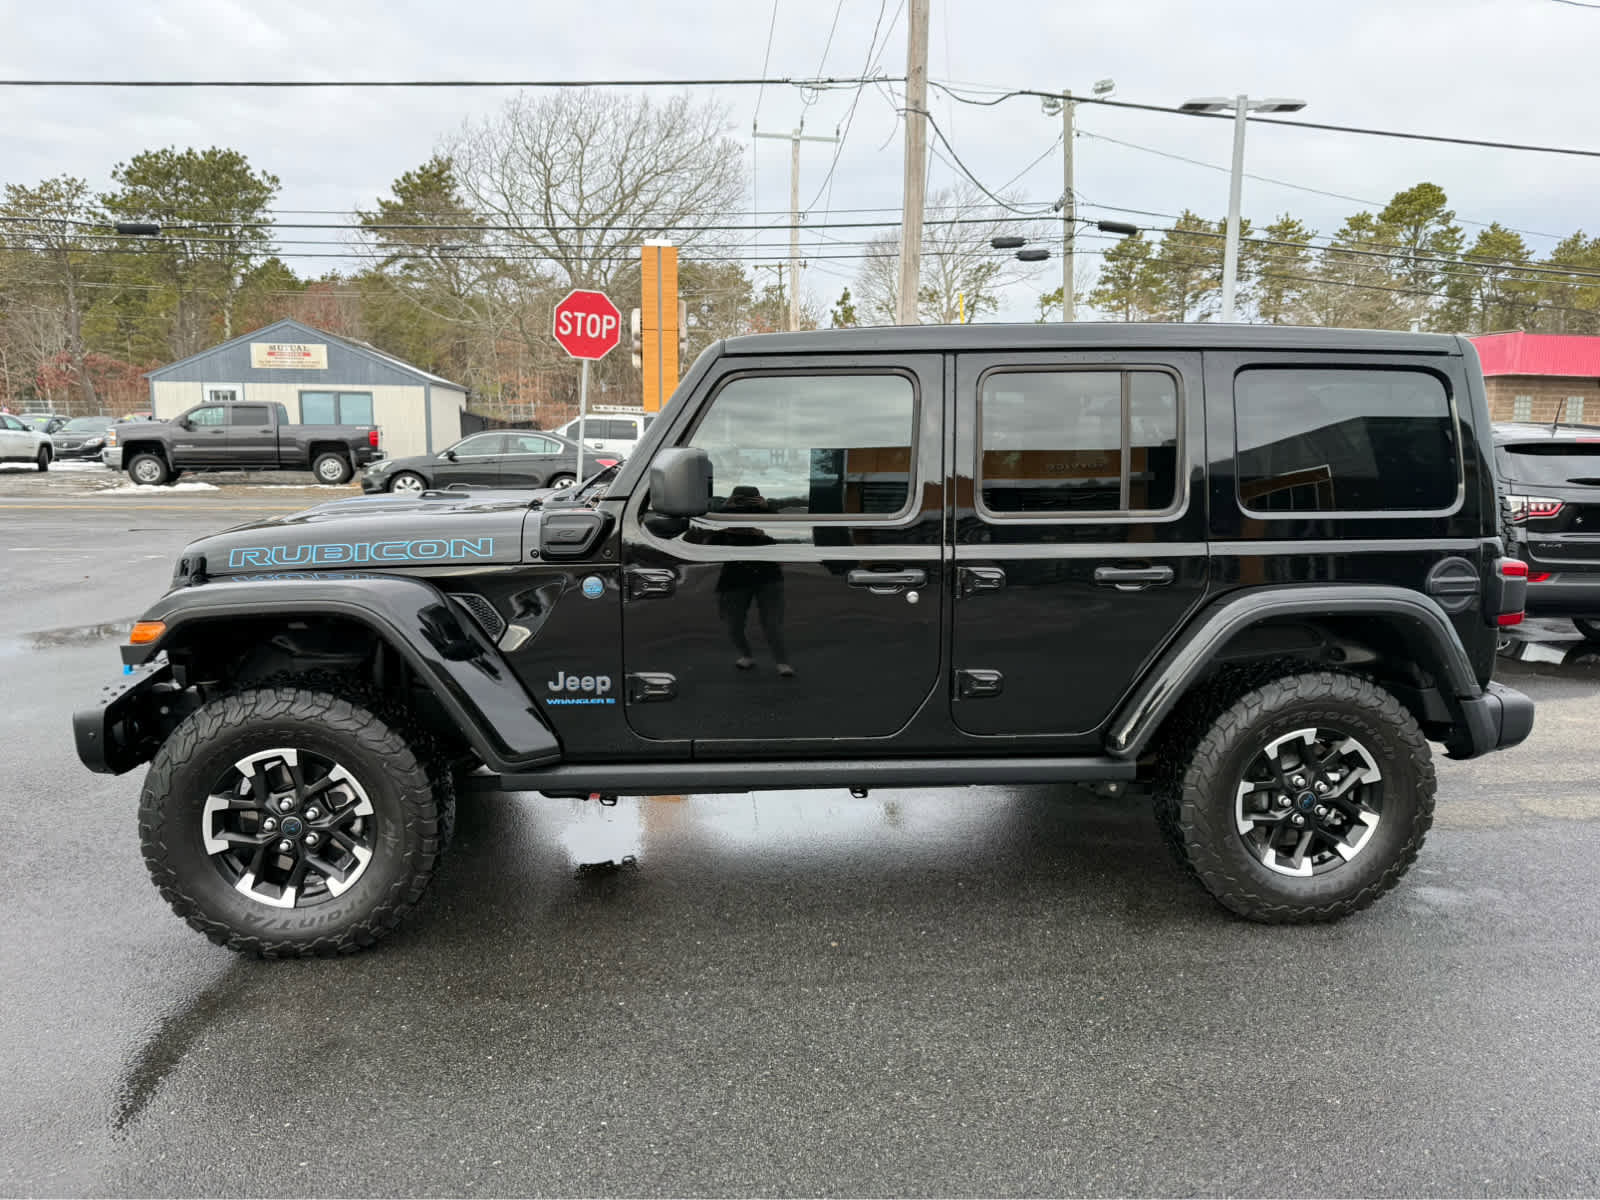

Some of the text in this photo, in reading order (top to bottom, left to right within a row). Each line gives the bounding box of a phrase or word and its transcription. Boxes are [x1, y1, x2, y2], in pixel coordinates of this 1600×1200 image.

[558, 310, 616, 339] STOP
[228, 537, 494, 568] RUBICON
[547, 671, 612, 695] Jeep
